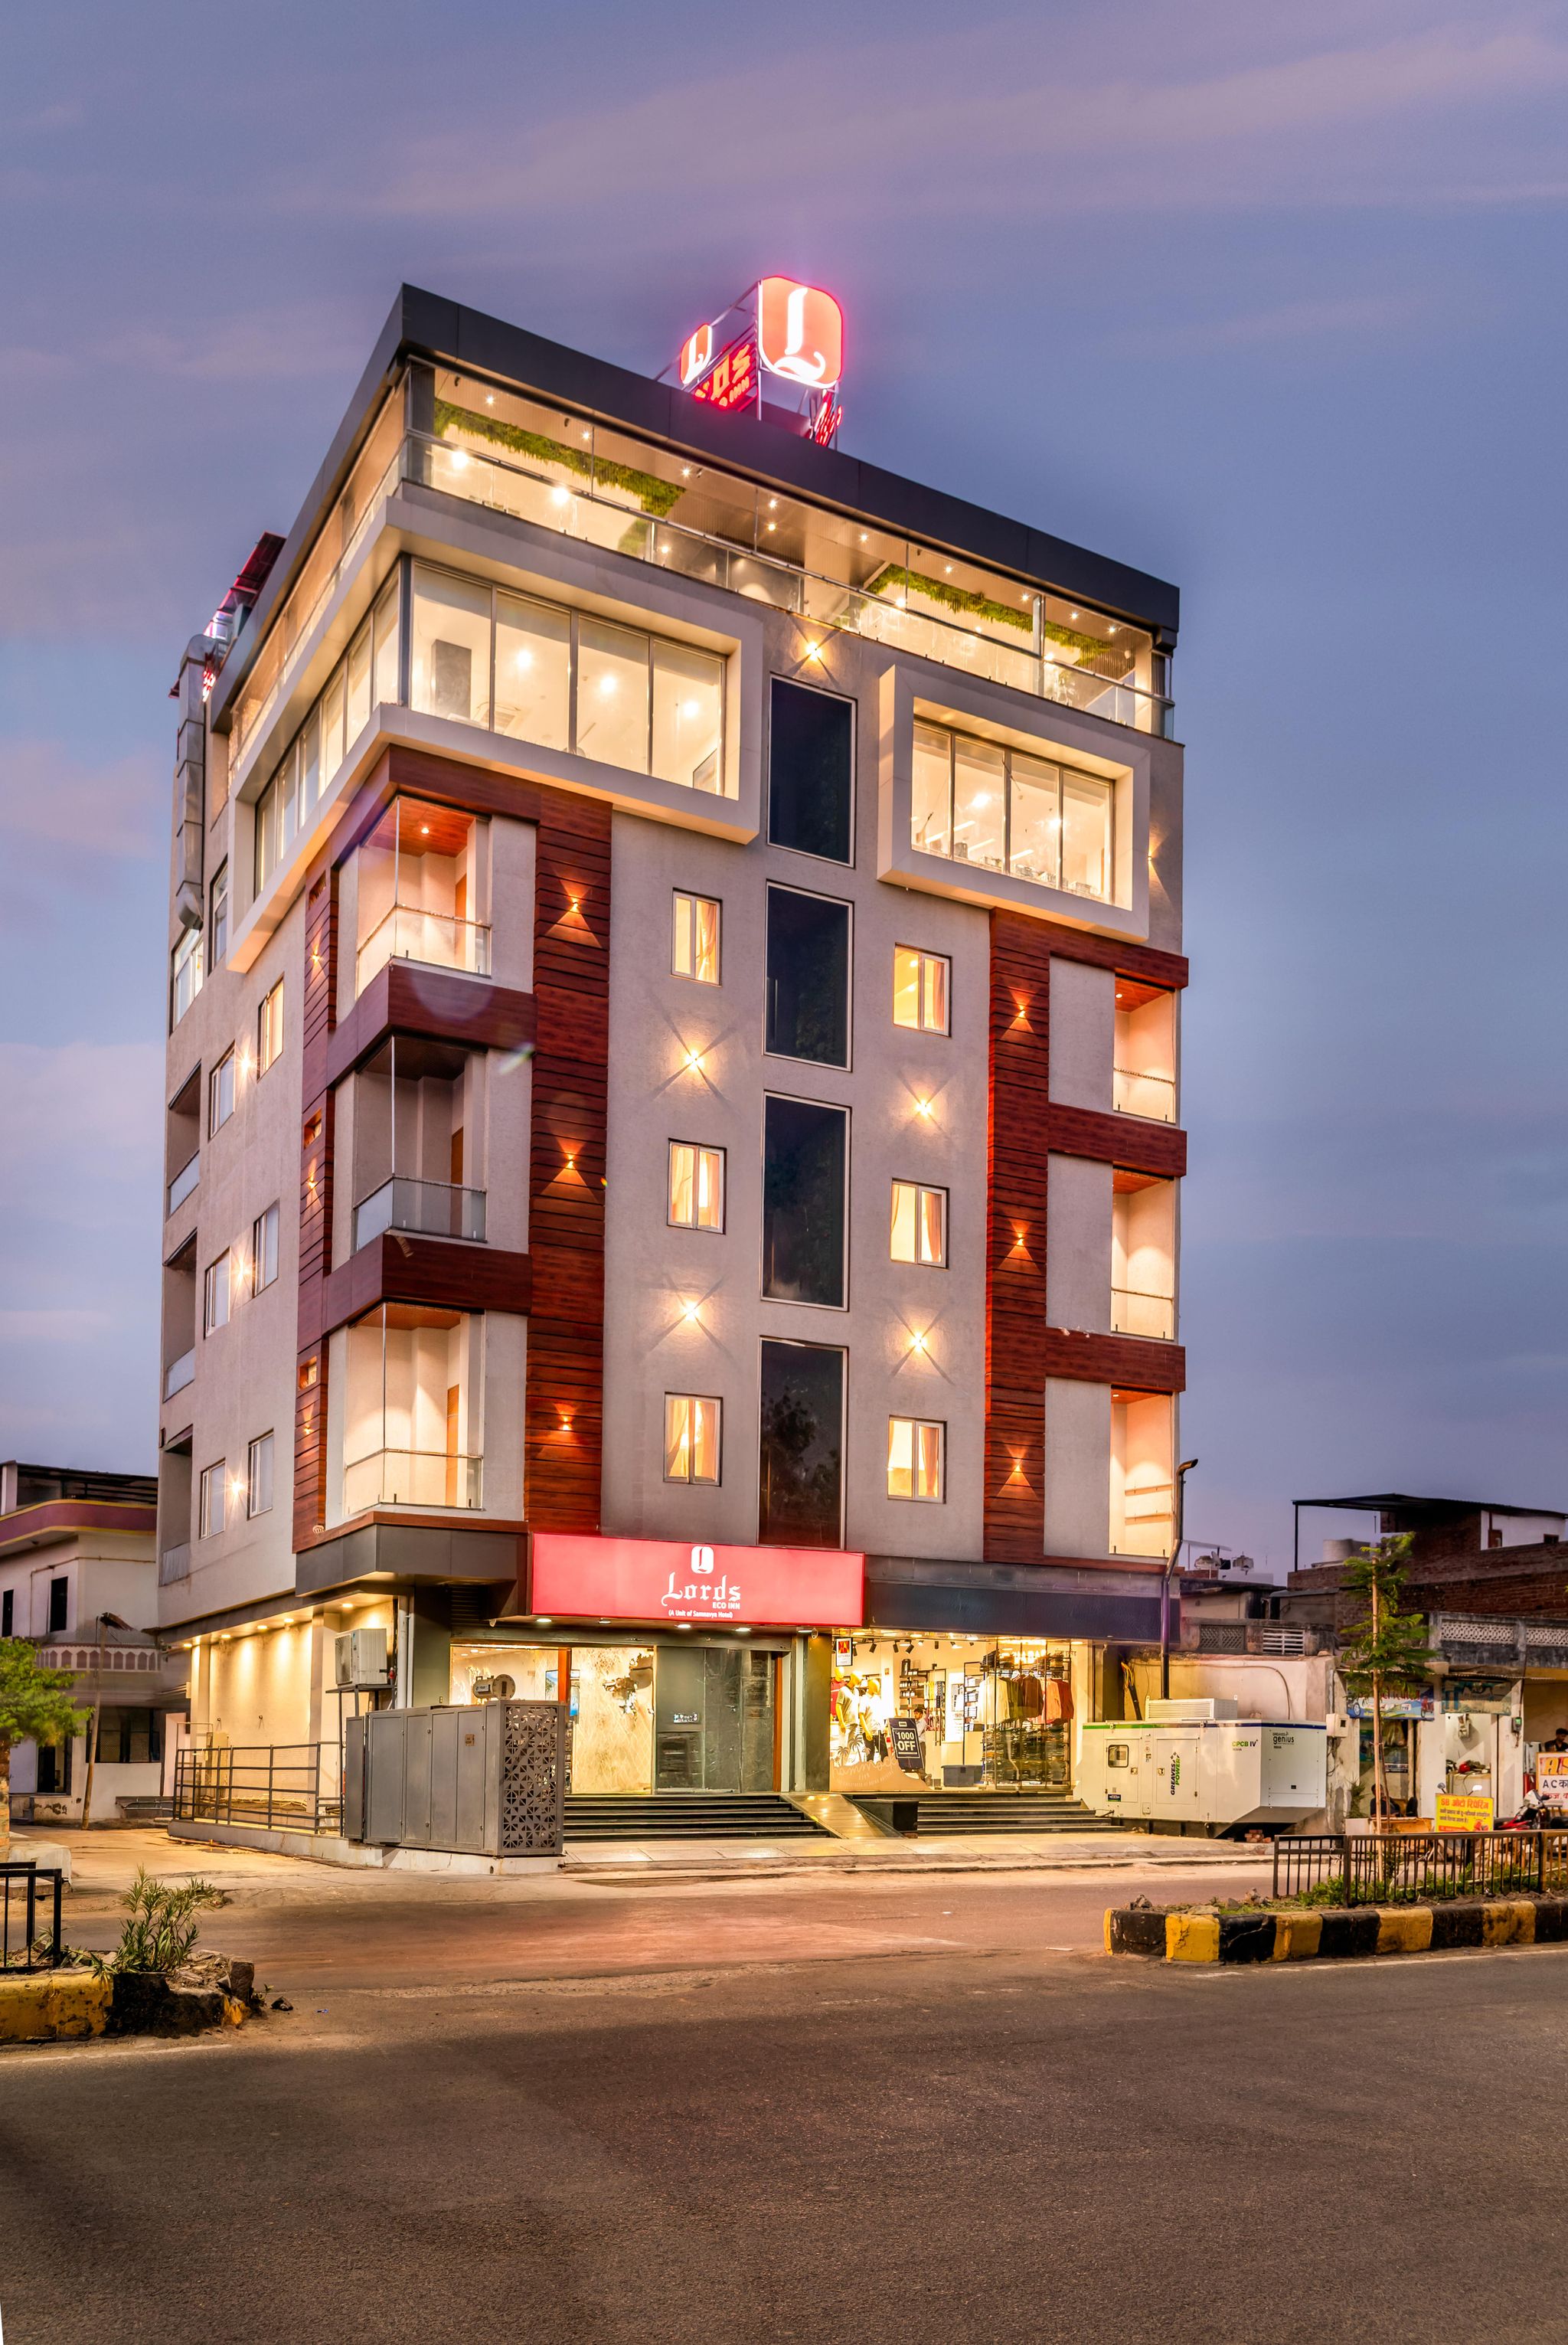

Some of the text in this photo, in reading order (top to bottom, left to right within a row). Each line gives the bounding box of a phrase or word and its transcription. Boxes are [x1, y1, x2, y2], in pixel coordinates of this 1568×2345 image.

[661, 1572, 741, 1607] Lords
[1272, 1736, 1295, 1745] genius
[897, 1741, 916, 1751] OFF
